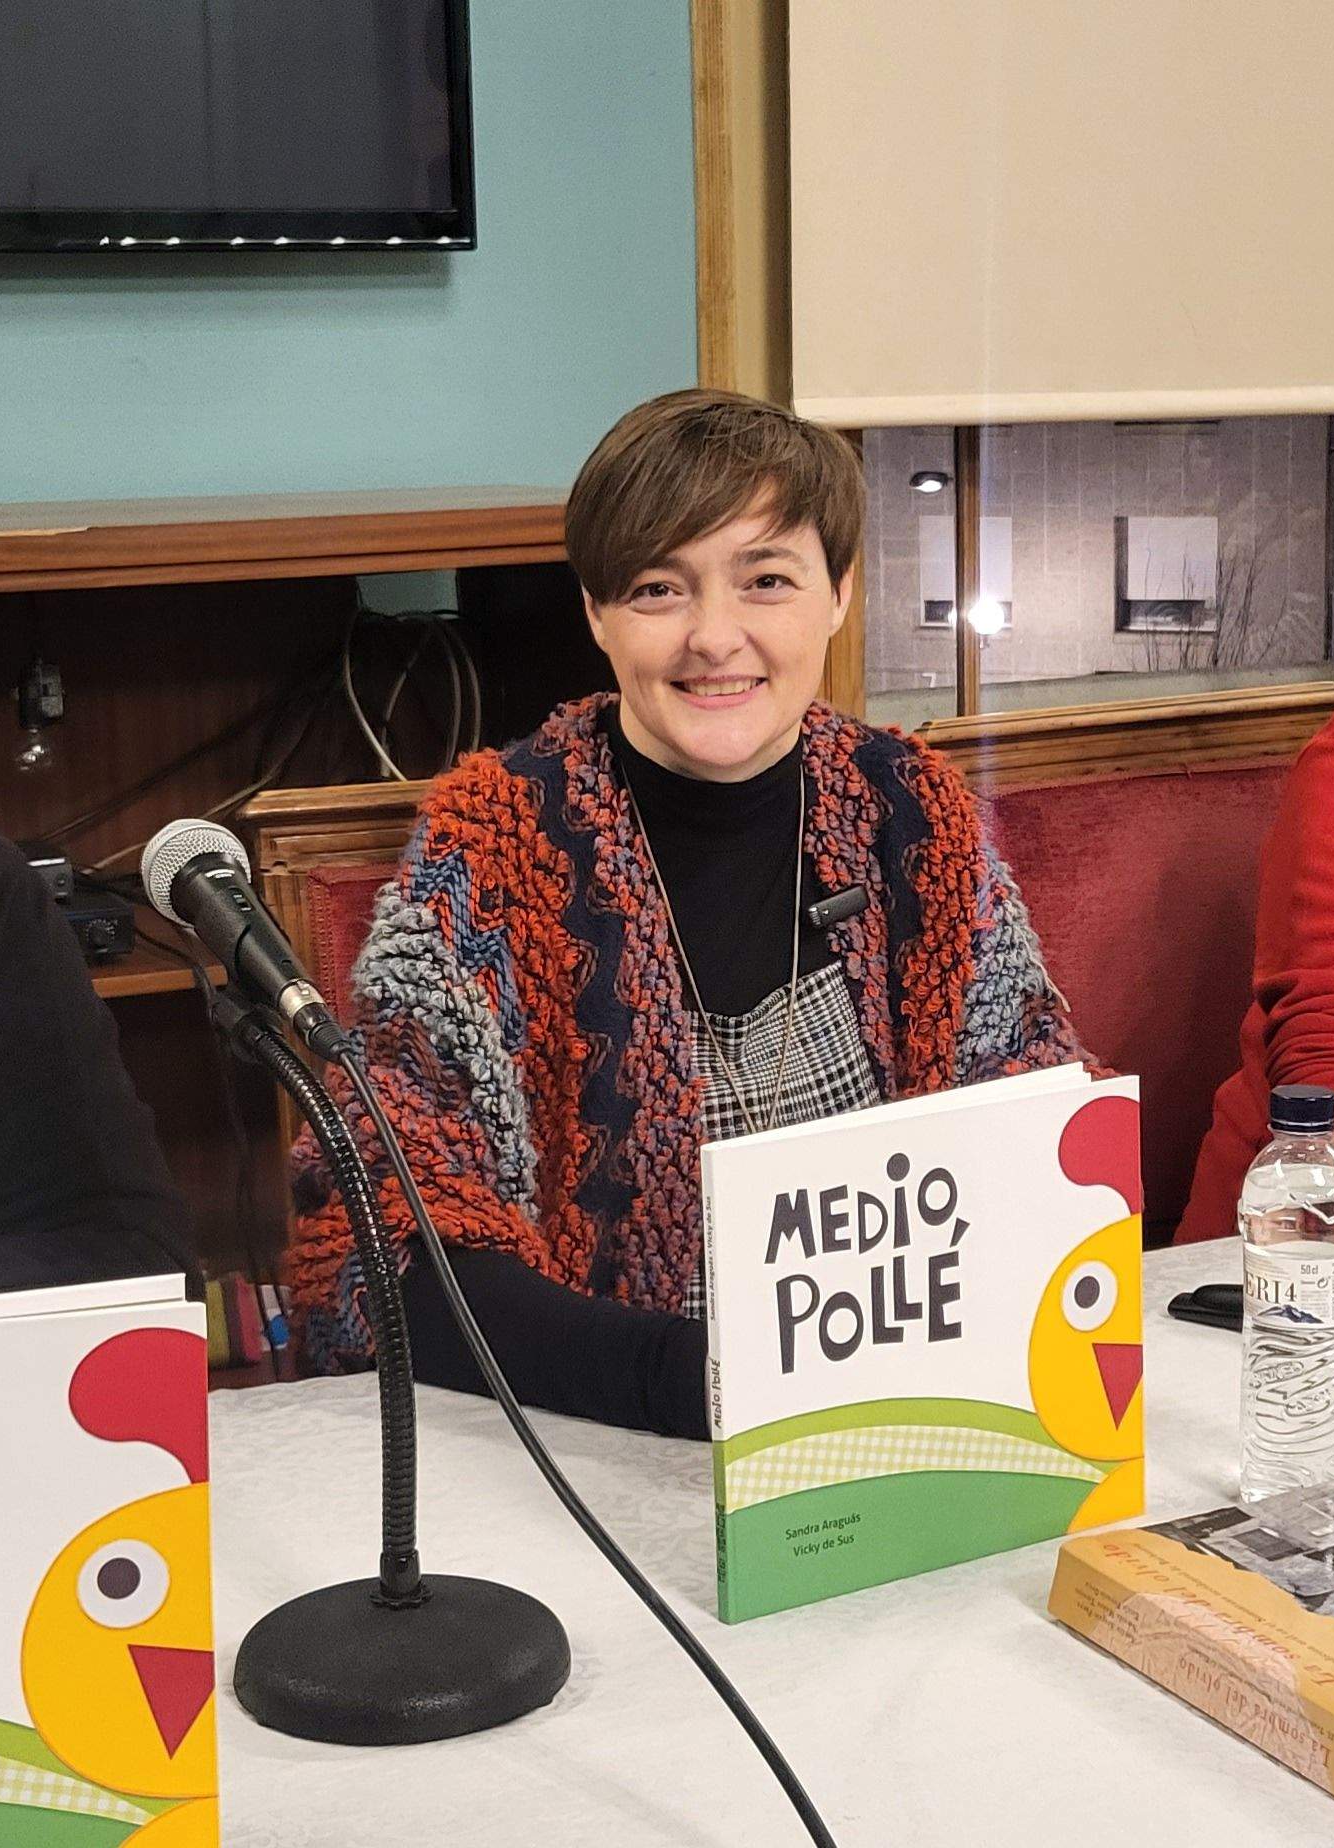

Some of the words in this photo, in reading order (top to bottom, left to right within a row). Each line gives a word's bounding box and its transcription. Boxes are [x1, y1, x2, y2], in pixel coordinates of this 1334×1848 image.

[785, 1524, 820, 1541] Sandra
[822, 1512, 862, 1531] Araguás
[793, 1543, 821, 1558] Vicky
[822, 1538, 835, 1551] de
[837, 1534, 855, 1547] Sus
[1103, 1544, 1171, 1582] olvido
[1163, 1586, 1212, 1607] del
[1214, 1612, 1301, 1660] sombra
[1178, 1656, 1221, 1693] olvido
[1225, 1685, 1248, 1713] del
[1254, 1703, 1306, 1744] sombra
[1312, 1739, 1332, 1768] La
